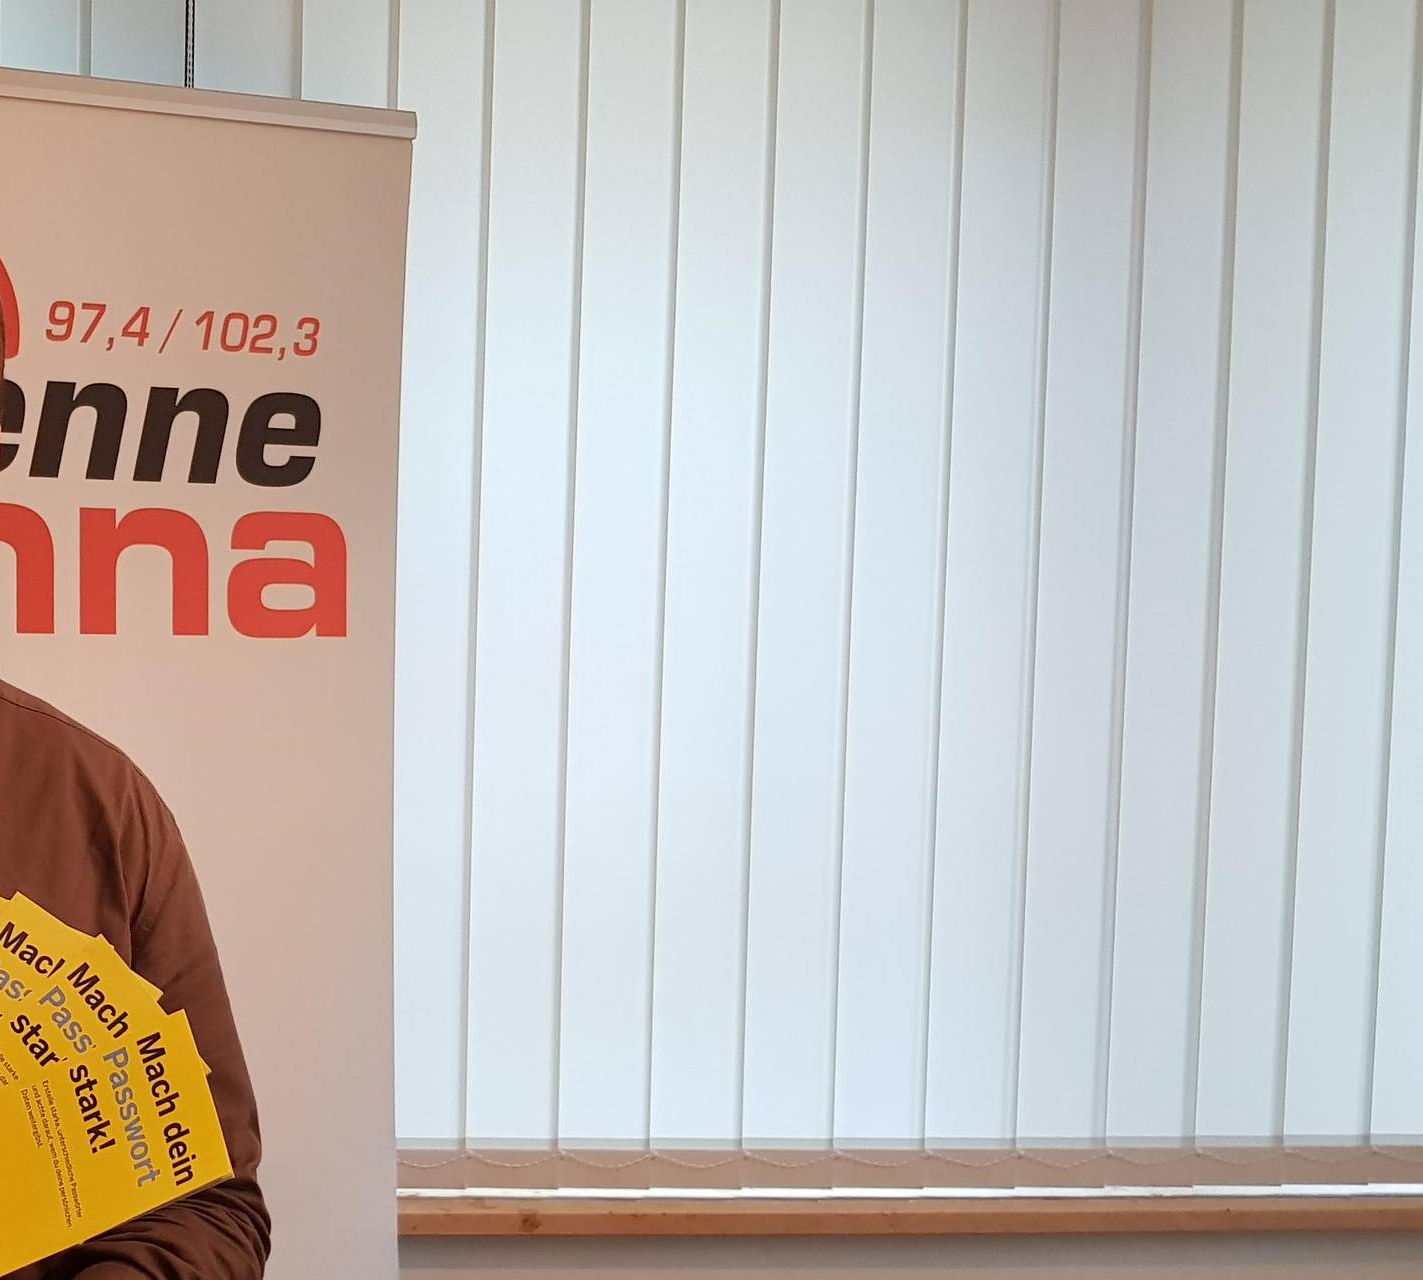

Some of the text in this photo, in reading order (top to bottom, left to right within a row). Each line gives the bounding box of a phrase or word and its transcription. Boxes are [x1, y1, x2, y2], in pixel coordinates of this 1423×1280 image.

[46, 301, 150, 351] 97,4
[195, 311, 320, 361] 102,3
[39, 985, 96, 1054] Pass
[66, 962, 129, 1039] Mach
[10, 1015, 68, 1067] star
[69, 1064, 117, 1154] stark!
[103, 1046, 161, 1188] Passwort
[136, 1031, 197, 1187] Mach dein
